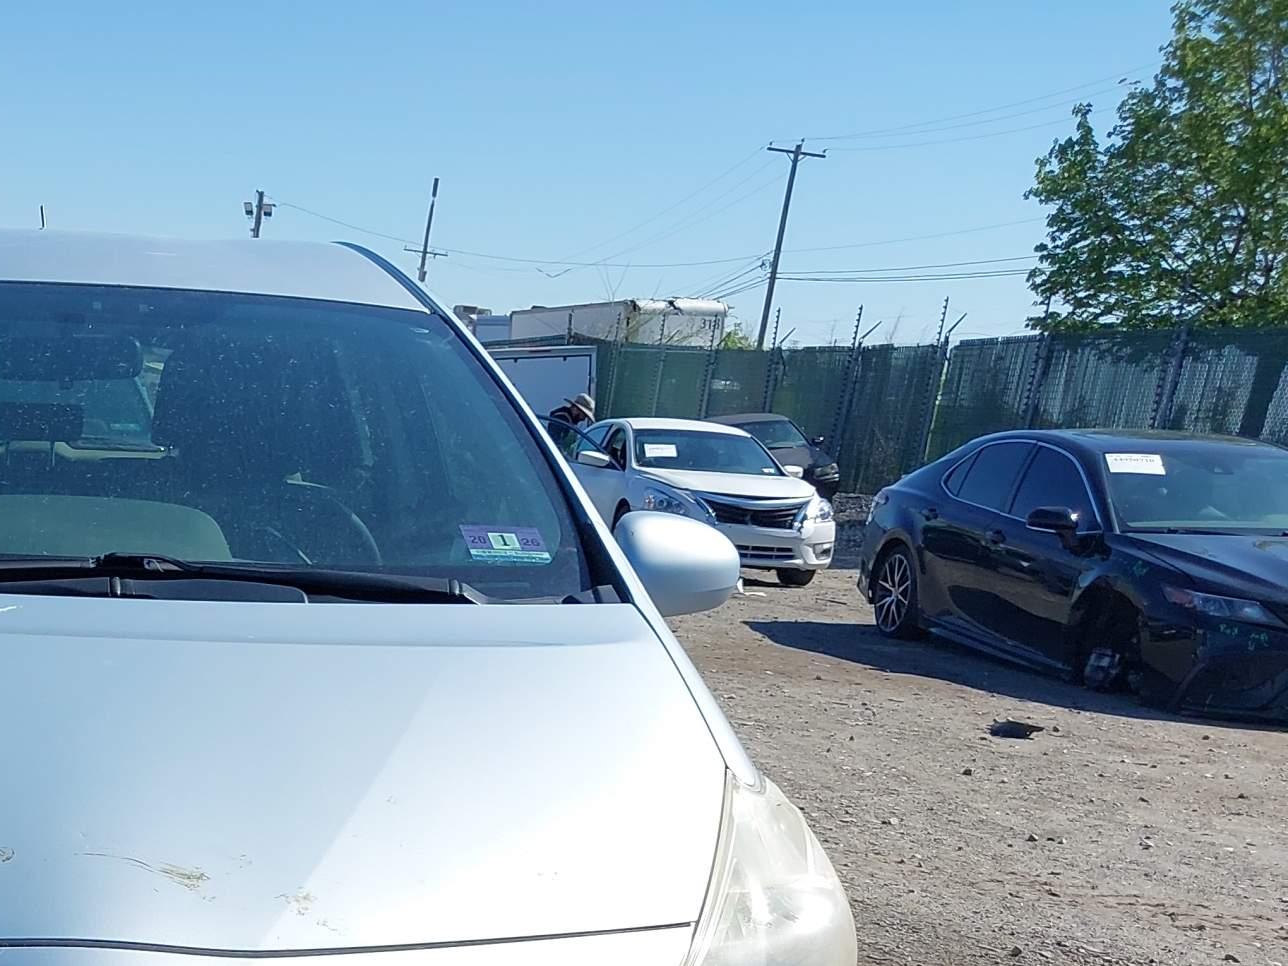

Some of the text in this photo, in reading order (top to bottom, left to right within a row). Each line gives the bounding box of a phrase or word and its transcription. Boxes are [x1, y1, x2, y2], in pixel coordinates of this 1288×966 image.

[468, 534, 541, 547] 20 1 26
